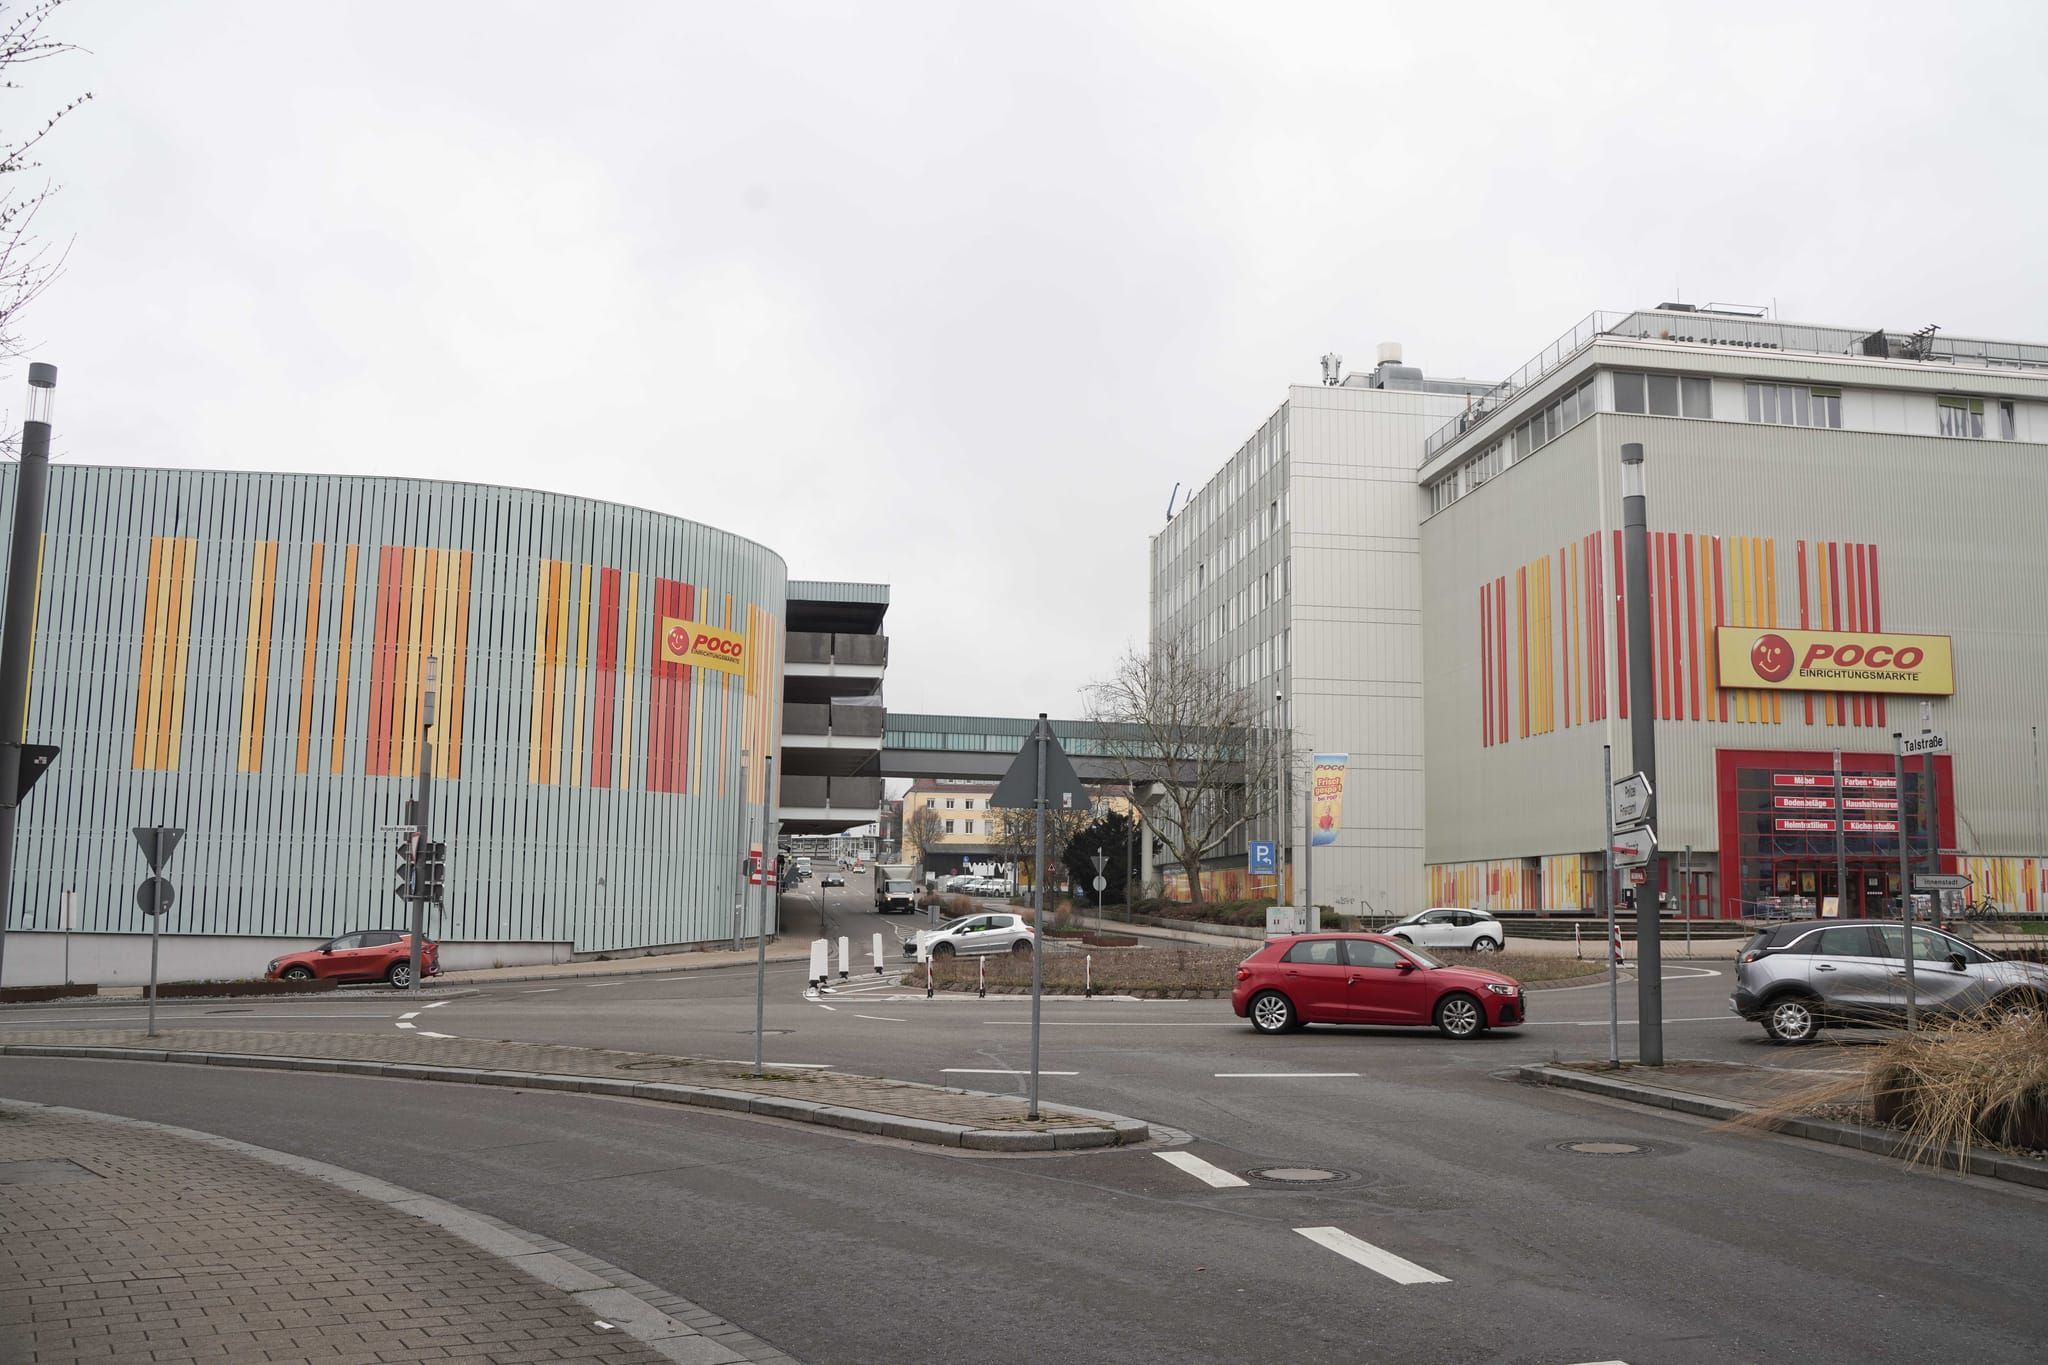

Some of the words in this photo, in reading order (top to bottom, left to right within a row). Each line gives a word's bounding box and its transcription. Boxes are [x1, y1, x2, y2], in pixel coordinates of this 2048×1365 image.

[693, 634, 742, 657] POCO
[1800, 644, 1924, 669] POCO
[1904, 735, 1943, 752] Talstraße
[1844, 778, 1867, 786] Farben
[1784, 798, 1827, 808] Bodenbeläge
[1256, 845, 1268, 862] P
